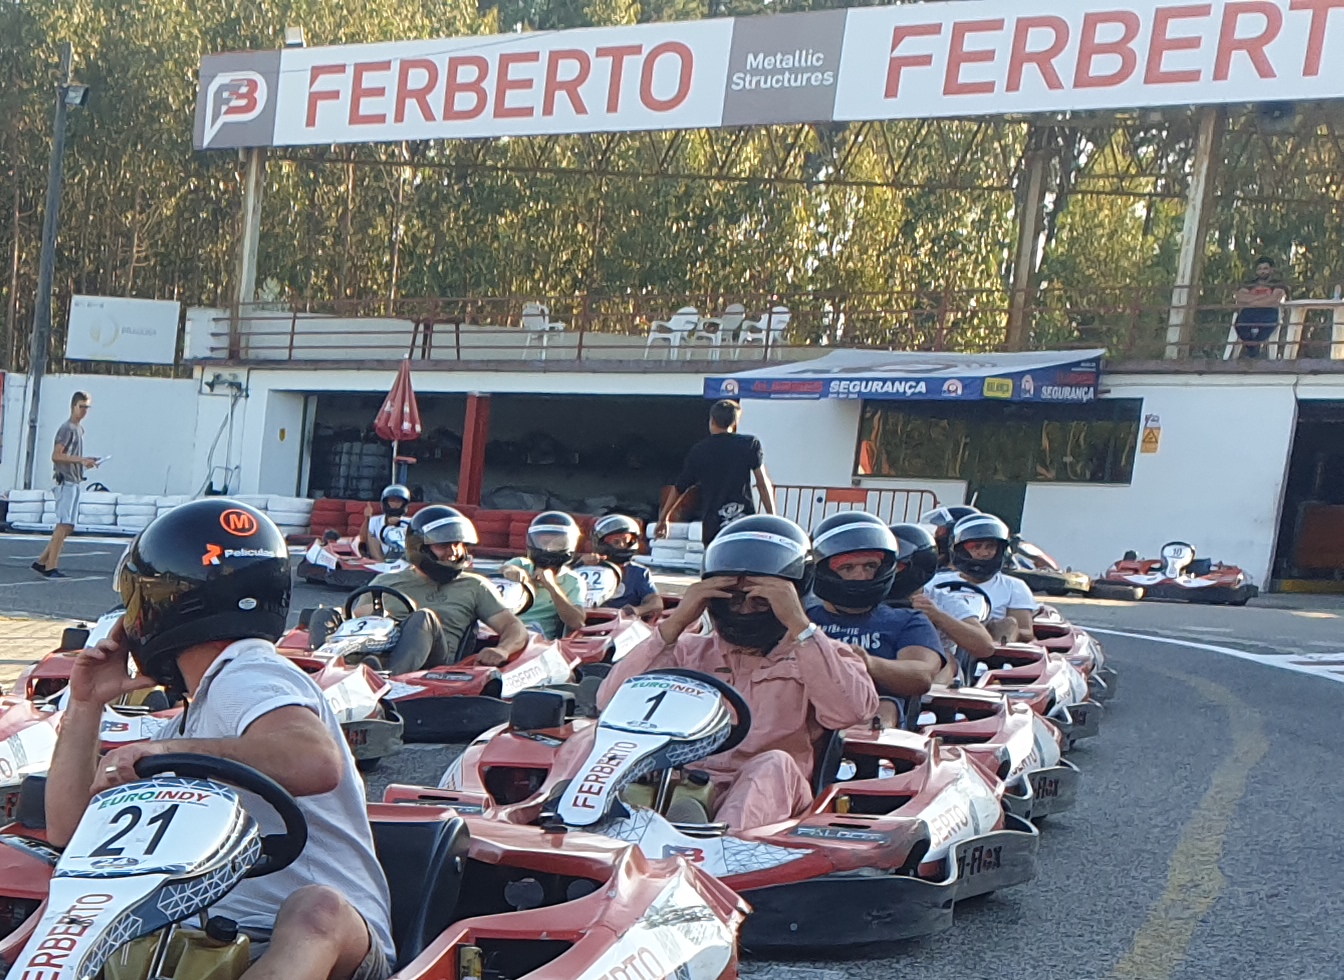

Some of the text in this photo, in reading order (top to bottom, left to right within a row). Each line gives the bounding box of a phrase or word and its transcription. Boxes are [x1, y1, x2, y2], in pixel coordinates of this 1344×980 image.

[745, 50, 825, 74] Metallic
[883, 0, 1344, 99] FERBERT
[307, 39, 694, 128] FERBERTO
[730, 67, 835, 91] Structures
[829, 380, 927, 397] SEGURANÇA
[631, 681, 705, 696] EUROINDY
[643, 690, 668, 722] 1
[572, 741, 639, 811] FERBERTO
[97, 790, 211, 811] EUROINDY
[87, 803, 180, 858] 21
